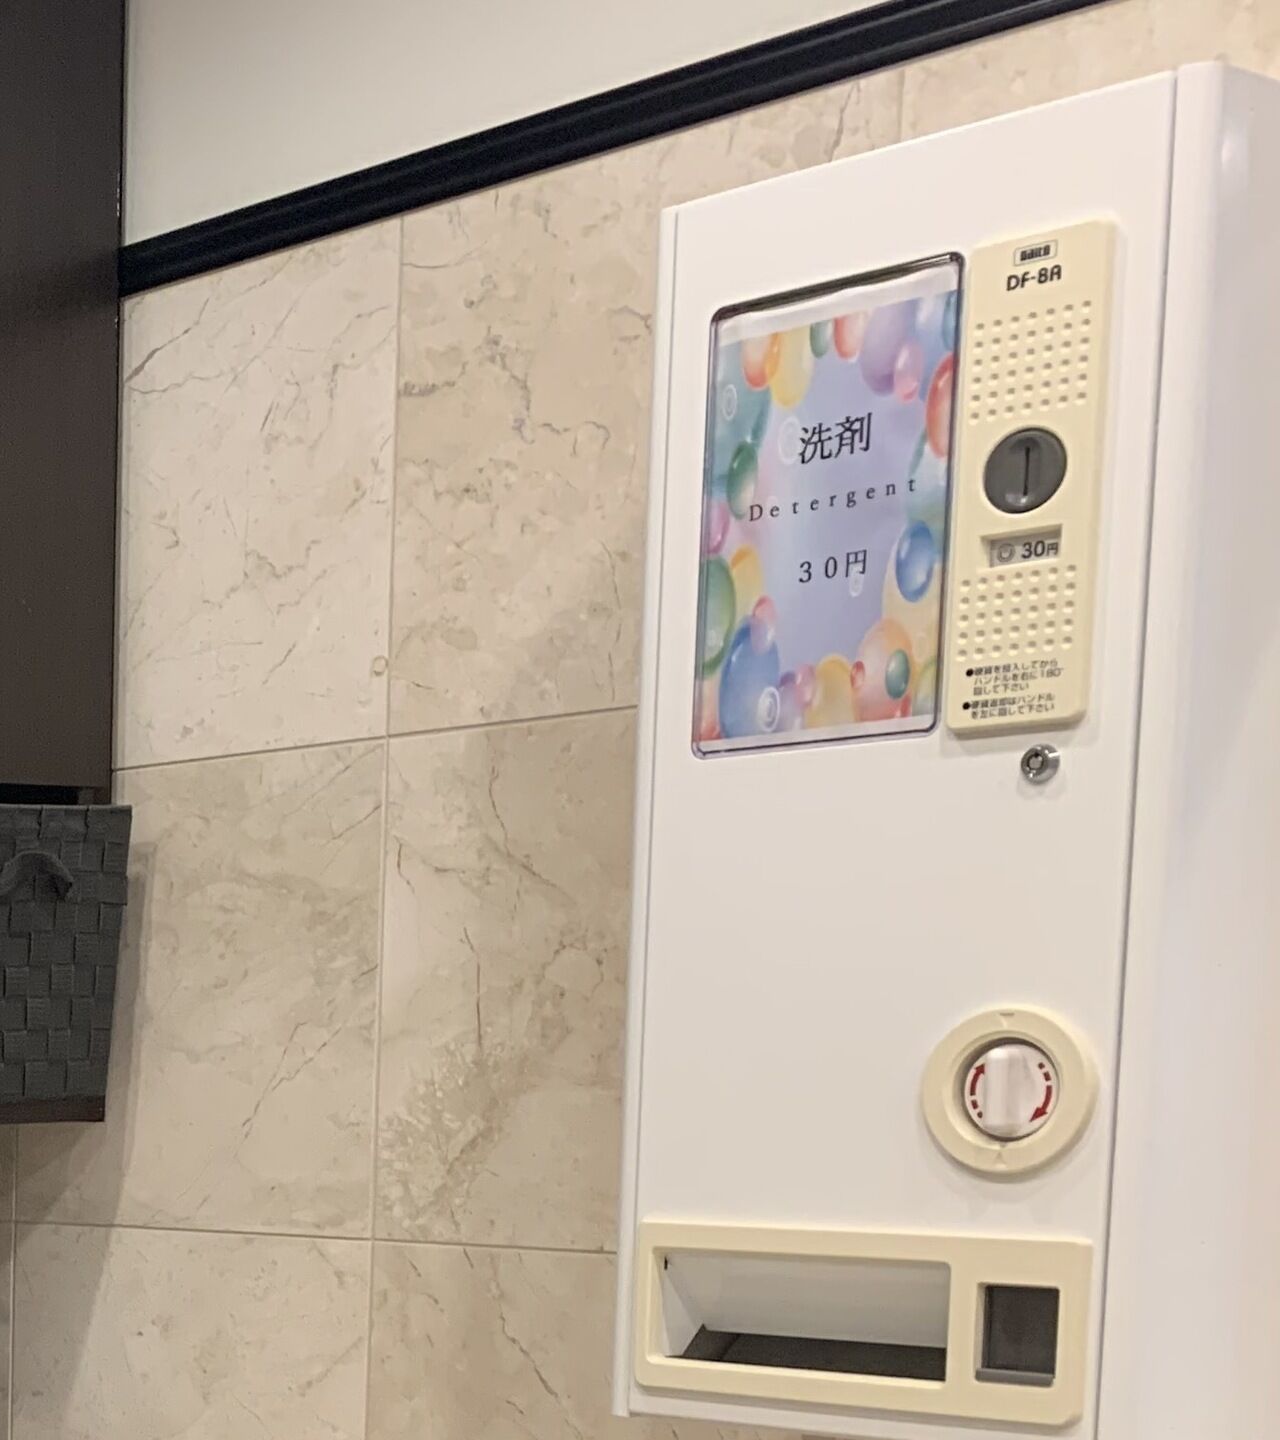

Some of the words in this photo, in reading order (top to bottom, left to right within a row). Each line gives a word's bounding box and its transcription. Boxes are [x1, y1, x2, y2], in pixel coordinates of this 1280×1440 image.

[1006, 264, 1062, 291] DF-8A
[799, 412, 873, 464] 洗剤
[748, 478, 916, 522] Detergent
[798, 549, 868, 583] 30円
[1021, 540, 1059, 559] 30円
